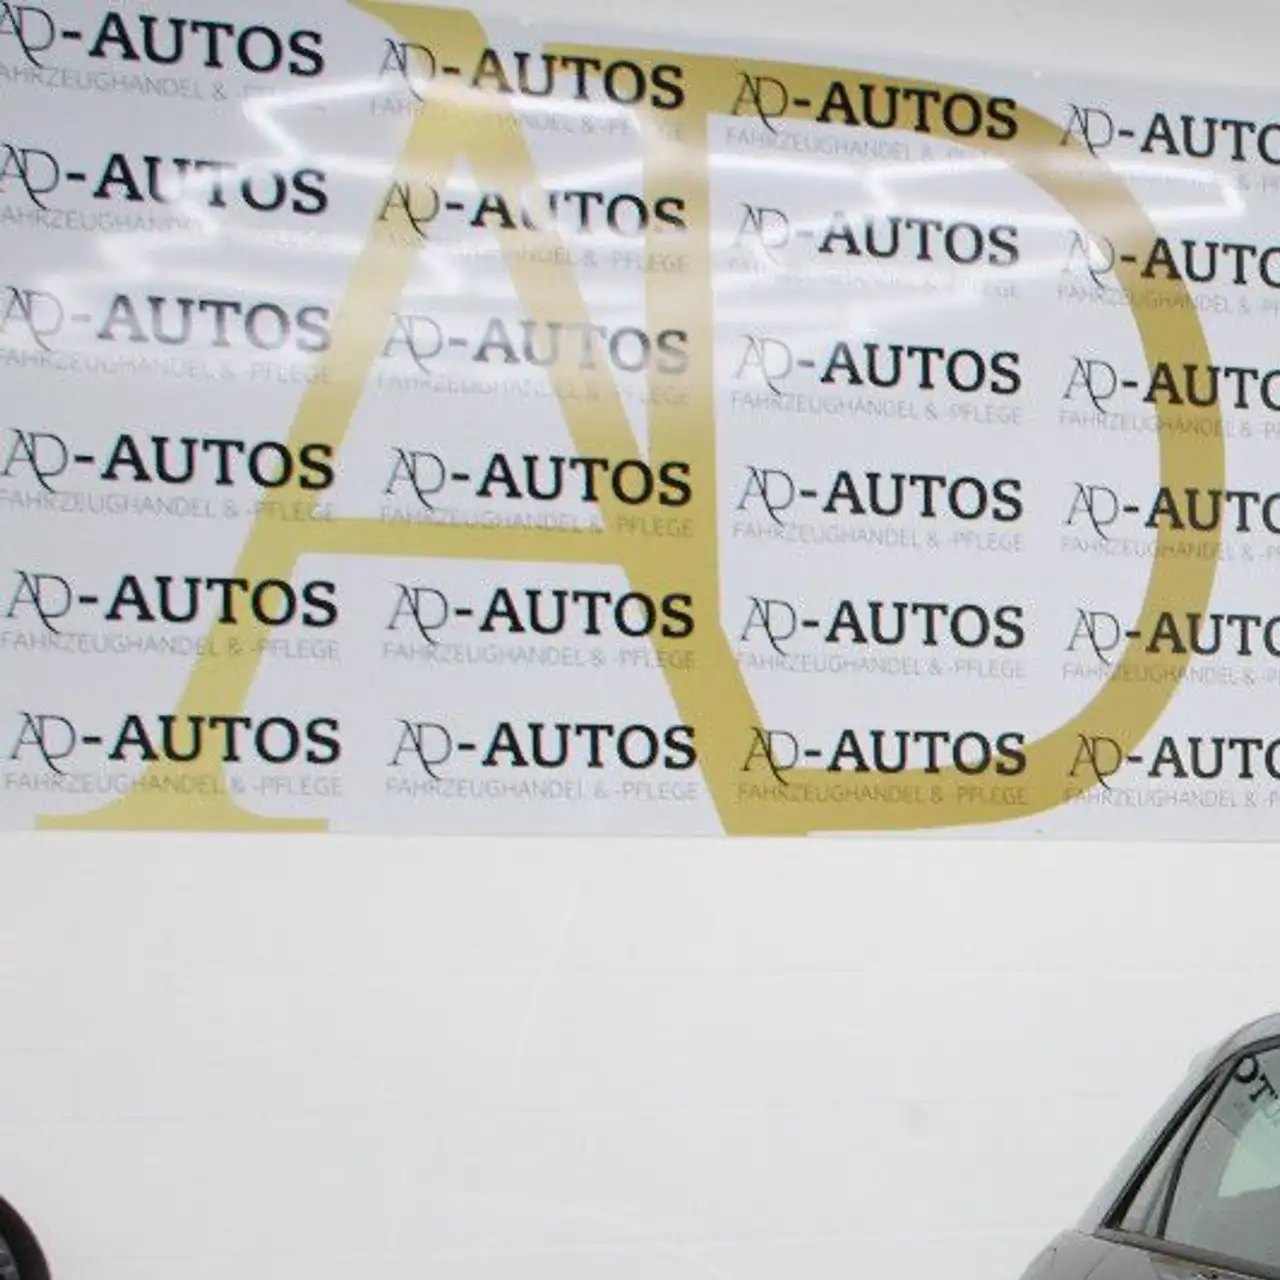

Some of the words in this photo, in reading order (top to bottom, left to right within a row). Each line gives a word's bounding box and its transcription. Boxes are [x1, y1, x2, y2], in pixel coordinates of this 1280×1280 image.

[0, 1, 325, 79] AD-AUTOS
[0, 64, 204, 100] AHRZEUGHANDEL
[373, 37, 685, 111] AD-AUTOS
[729, 71, 1018, 141] AD-AUTOS
[731, 203, 1020, 269] AD-AUTOS
[0, 286, 332, 354] AD-AUTOS
[379, 311, 690, 375] AD-AUTOS
[734, 334, 1022, 396] AD-AUTOS
[0, 428, 335, 493] AD-AUTOS
[382, 447, 693, 510] AD-AUTOS
[736, 465, 1024, 526] AD-AUTOS
[4, 569, 338, 634] AD-AUTOS
[385, 583, 695, 645] AD-AUTOS
[739, 596, 1026, 656] AD-AUTOS
[8, 710, 342, 774] AD-AUTOS
[389, 718, 698, 780] AD-AUTOS
[741, 726, 1028, 786] AD-AUTOS
